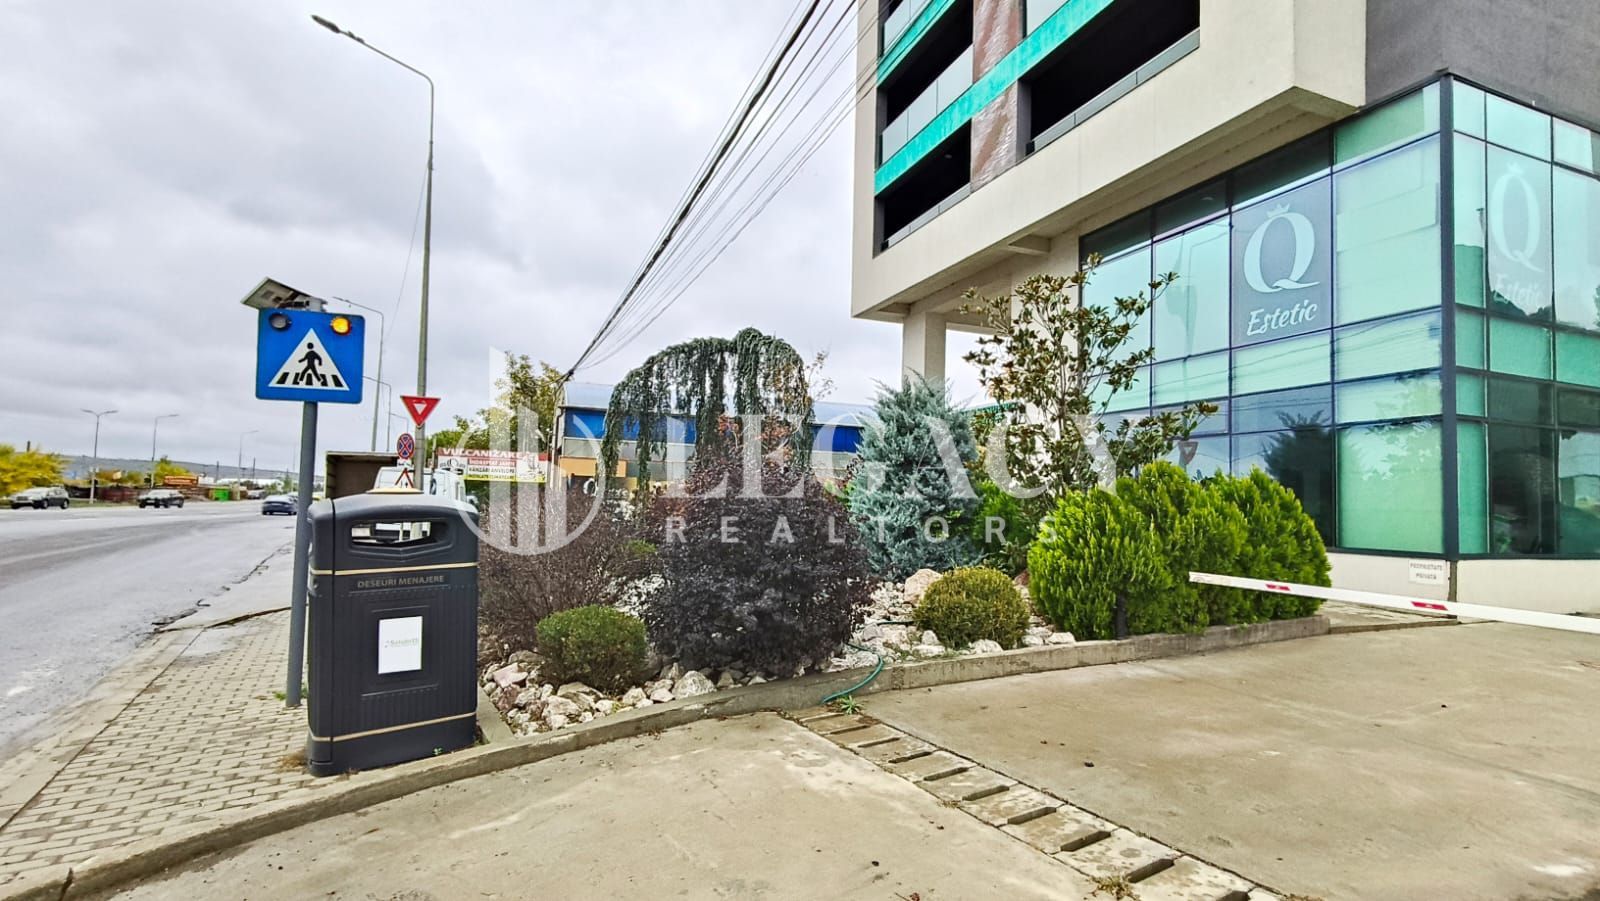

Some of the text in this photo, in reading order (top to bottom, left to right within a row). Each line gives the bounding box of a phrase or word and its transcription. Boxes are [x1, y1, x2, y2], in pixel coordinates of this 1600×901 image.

[1243, 211, 1321, 293] Q
[1490, 173, 1544, 273] Q
[1246, 300, 1318, 336] Estetic
[357, 575, 445, 588] DESEURI MENAJERE
